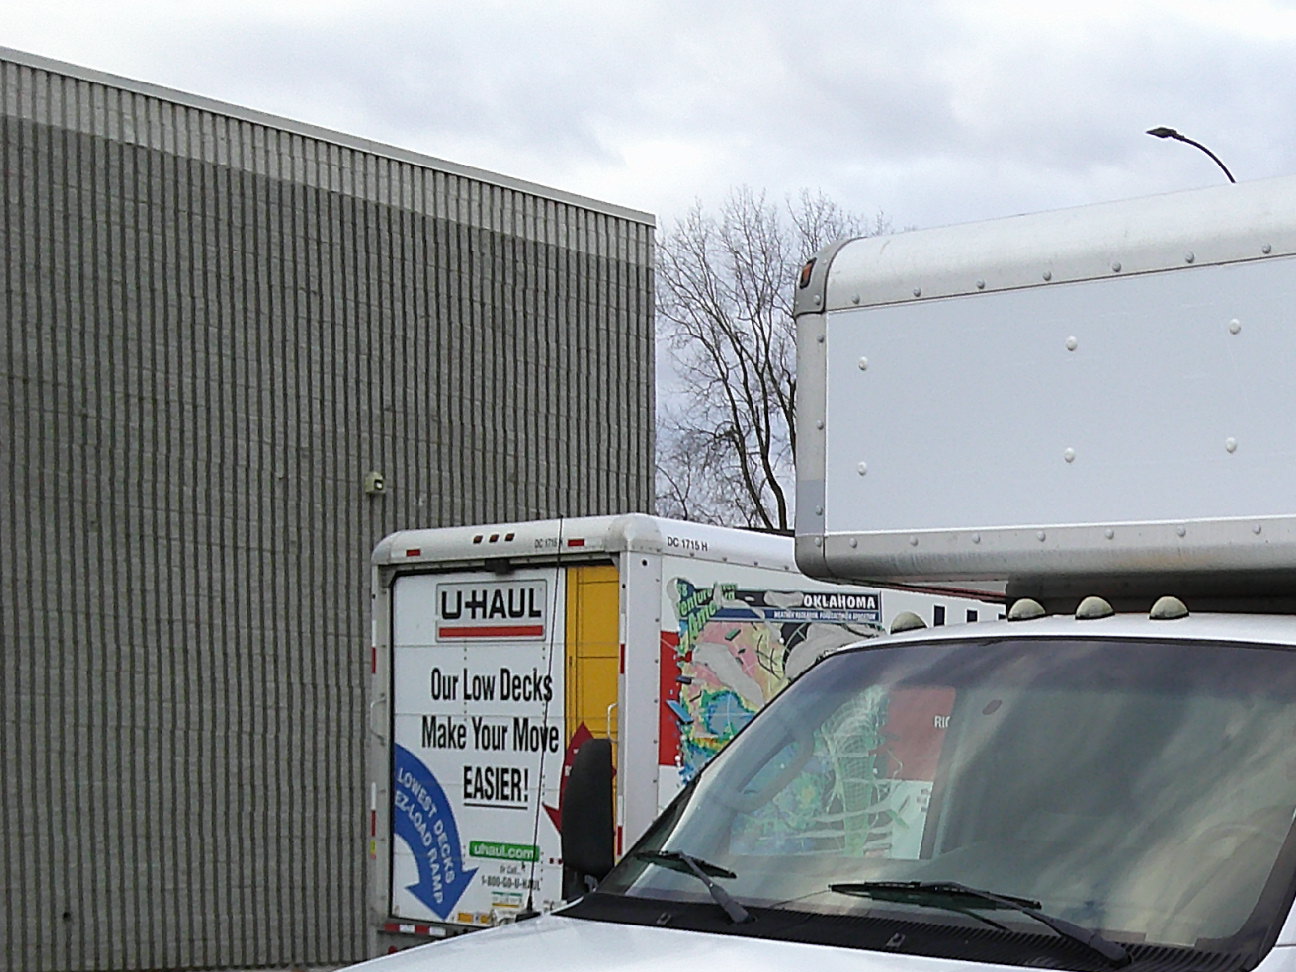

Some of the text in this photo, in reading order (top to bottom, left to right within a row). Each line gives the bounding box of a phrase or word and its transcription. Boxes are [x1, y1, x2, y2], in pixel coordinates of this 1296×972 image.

[667, 536, 708, 551] DC 1715 H
[441, 588, 542, 620] U-HAUL
[803, 592, 876, 609] OKLAHOMA
[431, 667, 553, 701] Our Low Decks
[422, 715, 560, 754] Make Your Move
[464, 765, 529, 803] EASIER!
[398, 767, 455, 884] LOWEST DECKS
[474, 843, 534, 859] uhaul.com
[428, 847, 444, 904] RAMP
